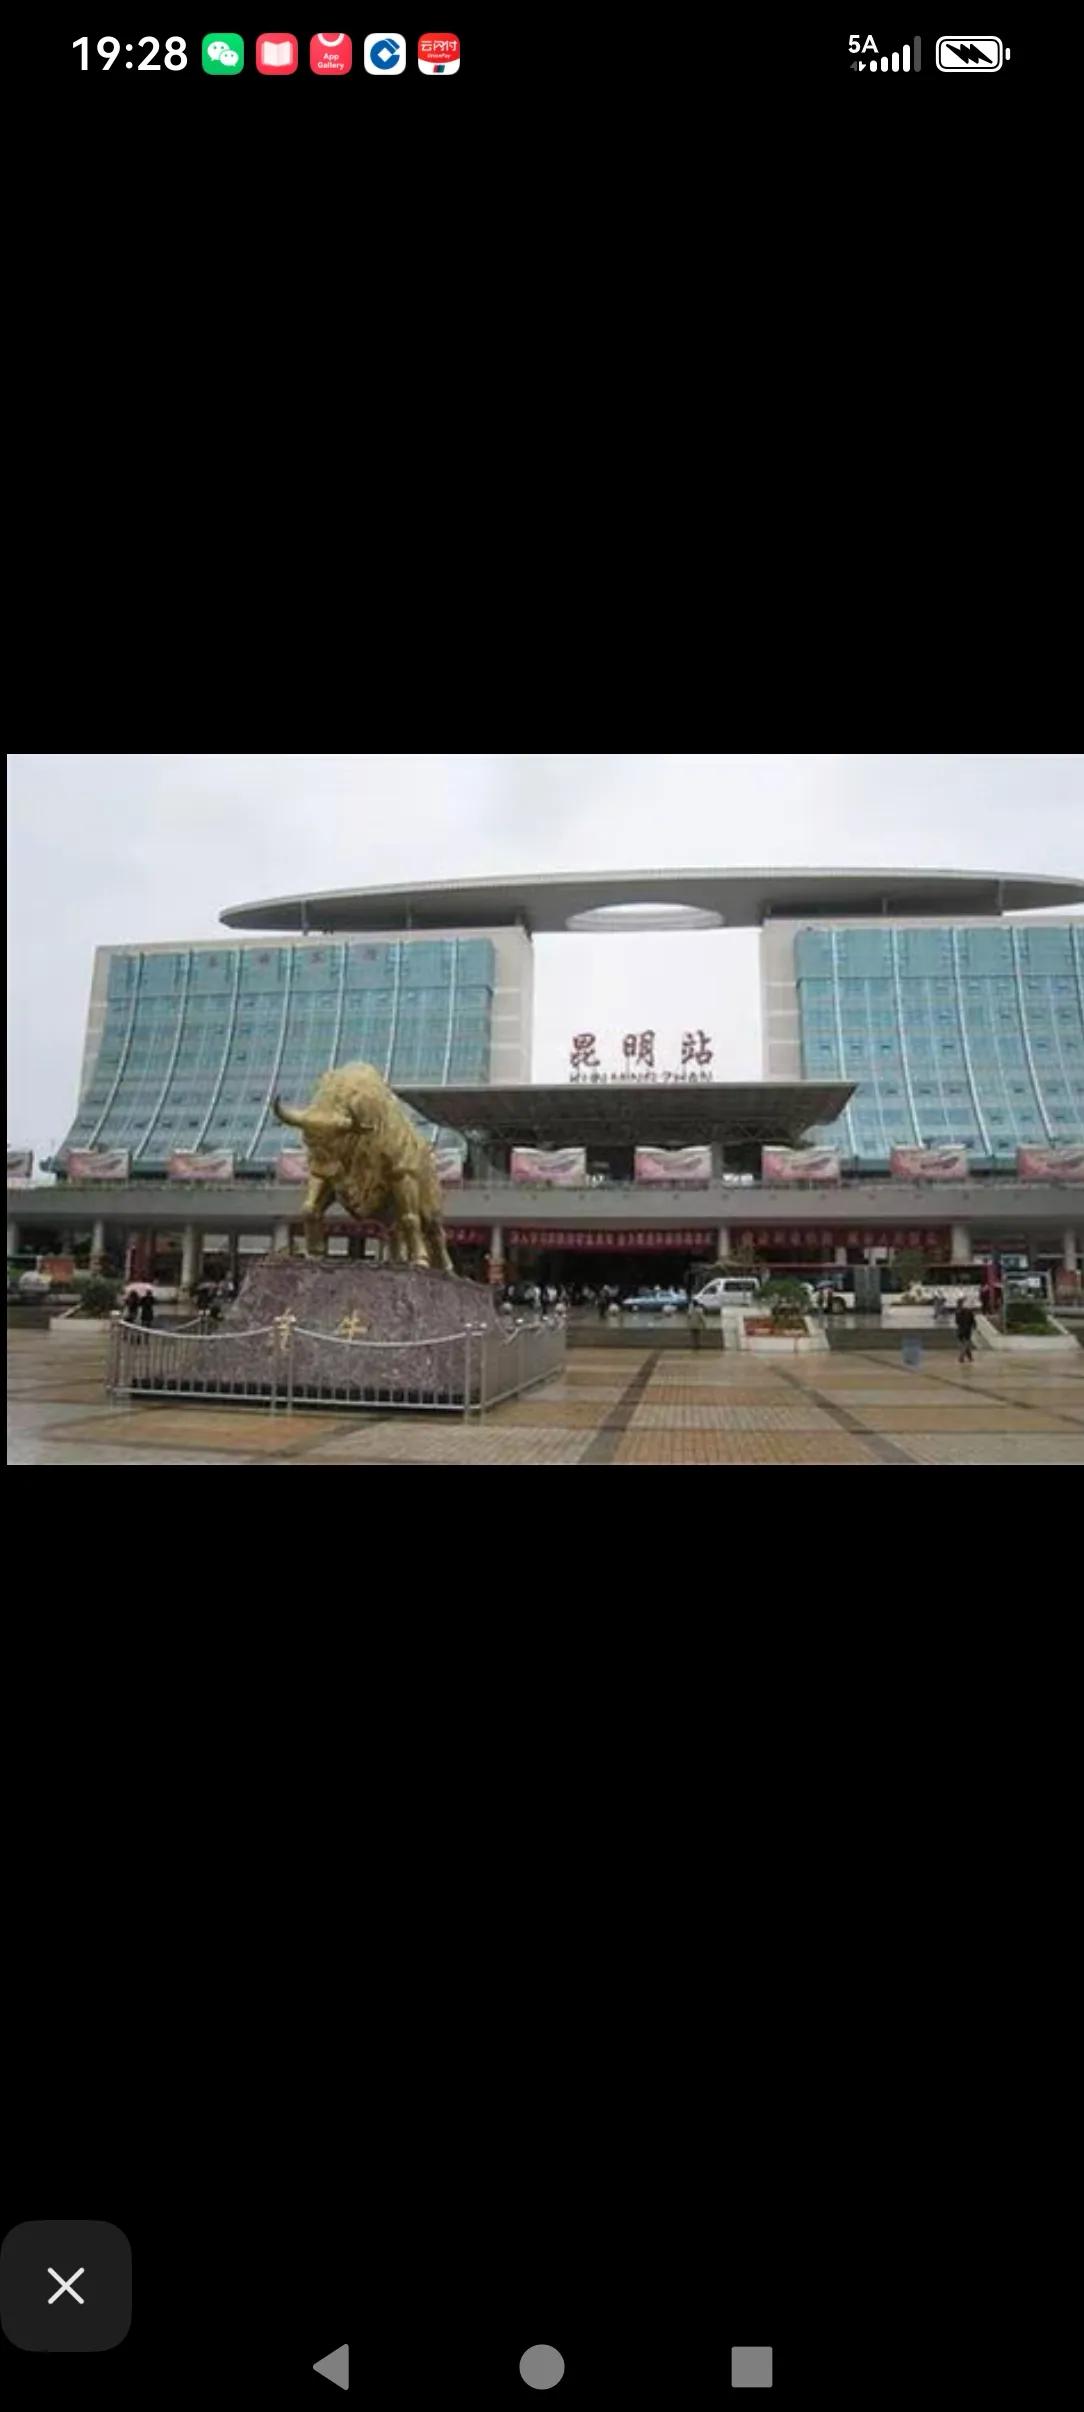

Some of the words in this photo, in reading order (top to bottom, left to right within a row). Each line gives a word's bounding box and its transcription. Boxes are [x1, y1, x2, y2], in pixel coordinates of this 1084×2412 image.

[72, 35, 188, 71] 19:28
[848, 34, 879, 54] 5A
[317, 61, 345, 71] Gallery
[322, 52, 340, 61] App
[570, 1029, 714, 1068] 昆明站
